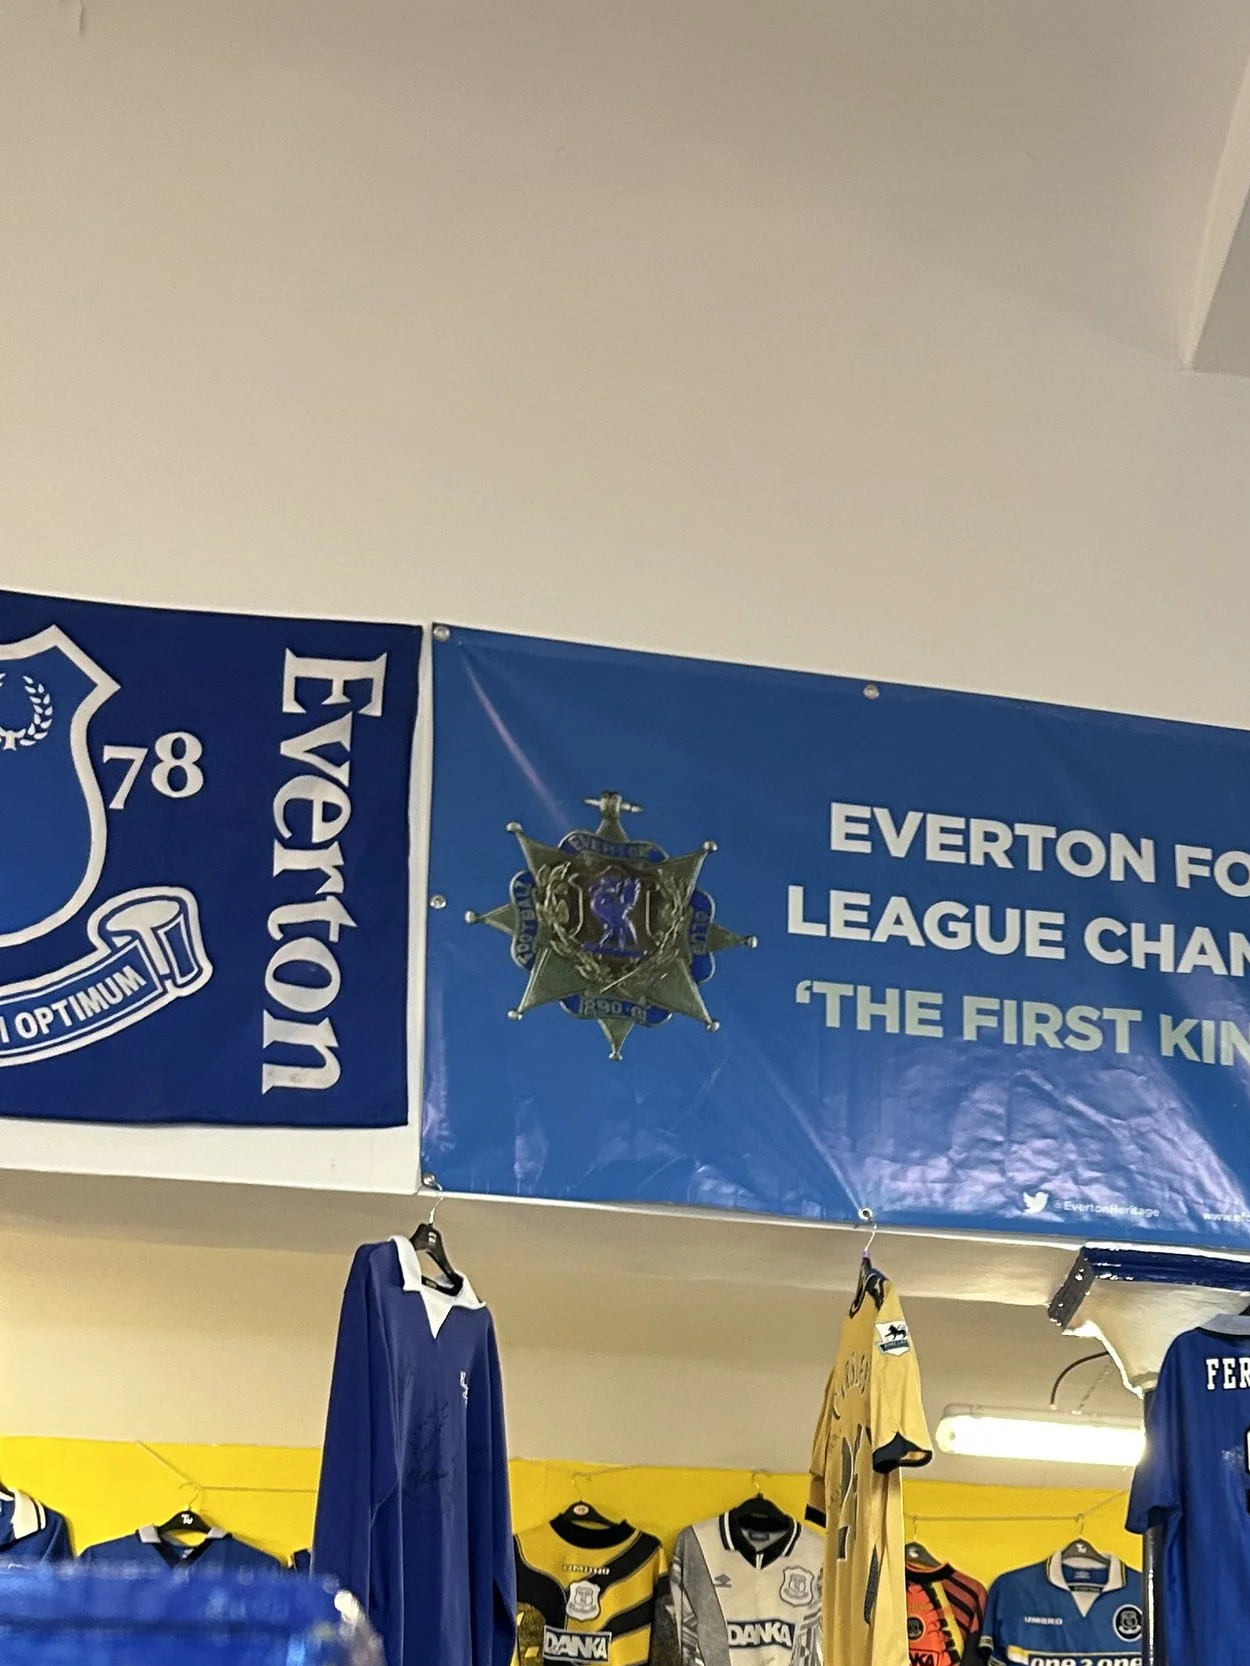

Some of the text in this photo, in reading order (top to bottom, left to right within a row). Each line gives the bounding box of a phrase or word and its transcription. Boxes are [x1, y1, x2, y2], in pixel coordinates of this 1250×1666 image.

[102, 732, 205, 811] 78
[262, 647, 388, 1095] Everton
[829, 801, 1157, 884] EVERTON
[787, 884, 1066, 960] LEAGUE
[16, 964, 147, 1041] OPTIMUM
[795, 979, 944, 1038] ‘THE
[962, 994, 1143, 1055] FIRST
[546, 1631, 608, 1659] DANKA
[728, 1622, 792, 1648] DANKA
